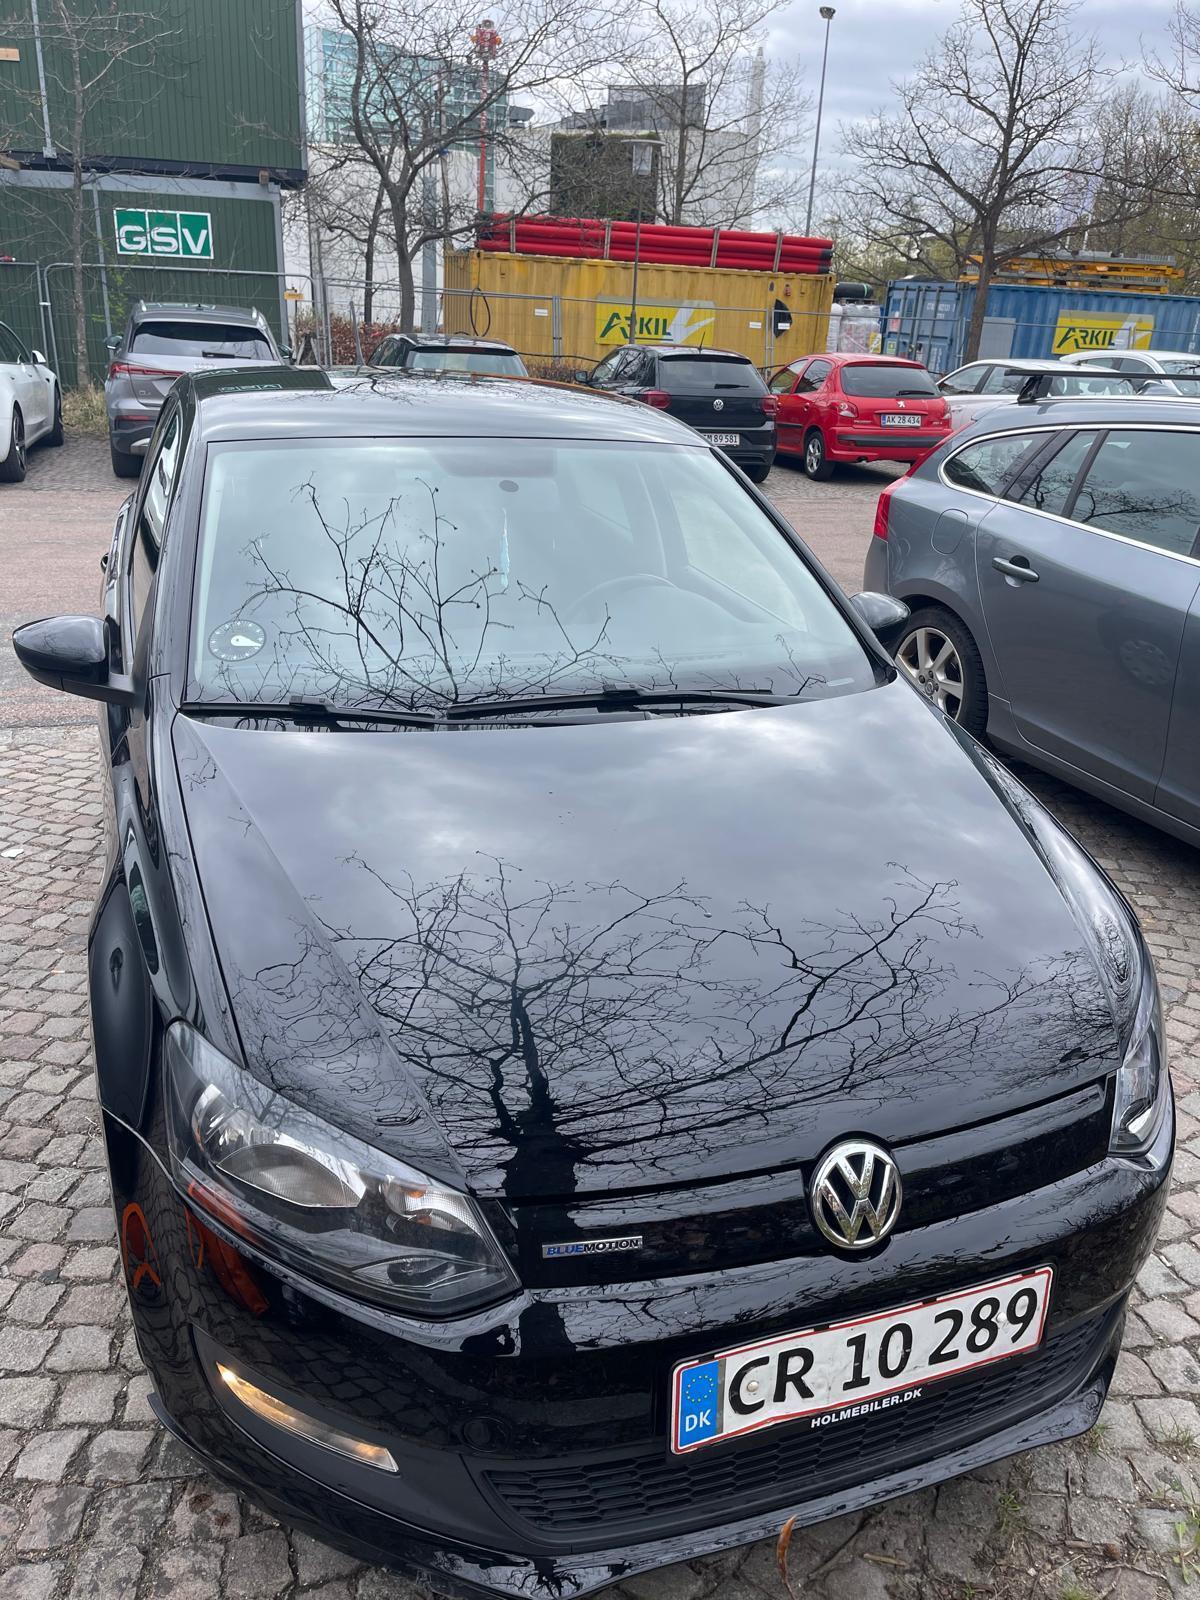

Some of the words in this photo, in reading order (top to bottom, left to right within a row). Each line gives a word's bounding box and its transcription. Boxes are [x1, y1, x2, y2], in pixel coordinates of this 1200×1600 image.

[120, 225, 207, 254] GSV
[1056, 327, 1115, 349] ARKIL
[886, 416, 895, 424] AK
[898, 416, 906, 424] 28
[908, 416, 919, 425] 434
[724, 435, 737, 443] 581
[546, 1239, 638, 1256] BLUEMOTION
[728, 1347, 815, 1415] CR
[842, 1322, 913, 1391] 10
[928, 1287, 1038, 1366] 289
[810, 1388, 922, 1428] HOLMEBILER.DK
[685, 1409, 711, 1433] DK
